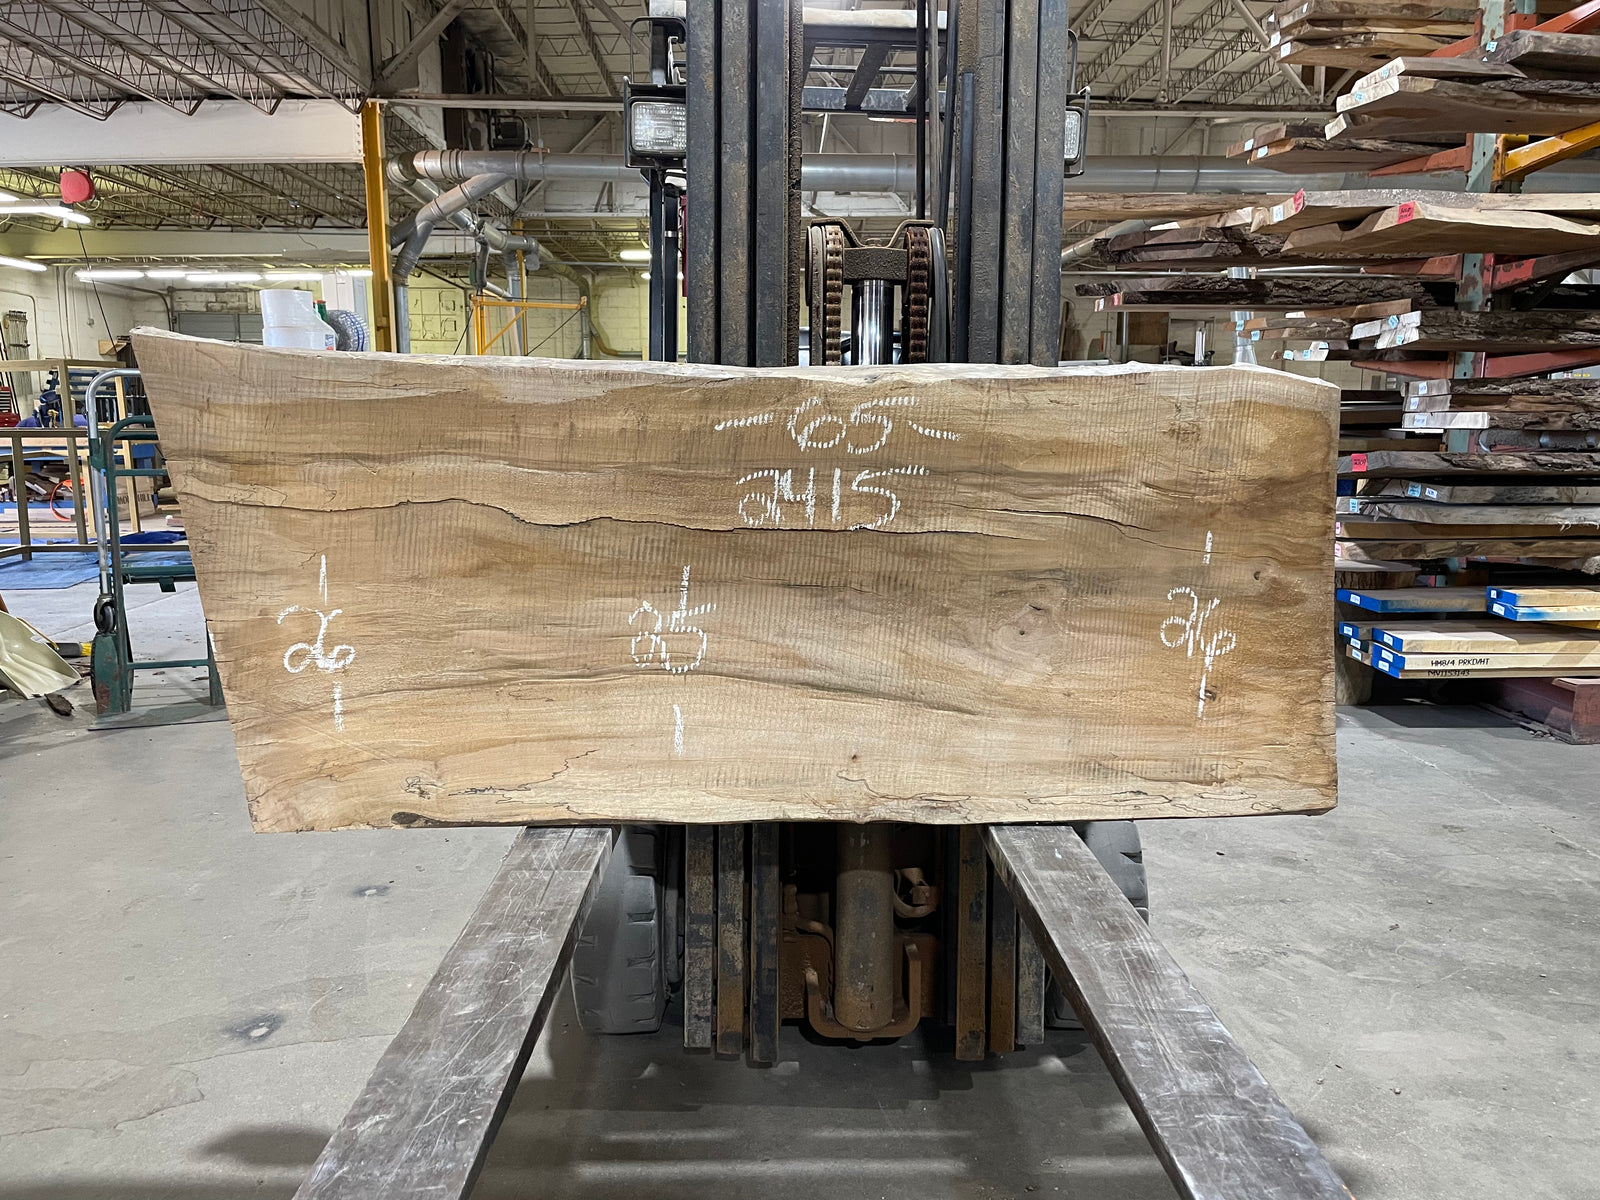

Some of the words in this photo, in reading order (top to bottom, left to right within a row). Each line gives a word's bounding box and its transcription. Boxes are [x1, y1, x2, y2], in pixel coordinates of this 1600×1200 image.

[787, 396, 919, 455] 65
[736, 465, 930, 531] 2415
[276, 604, 357, 674] 26
[628, 600, 717, 674] 25
